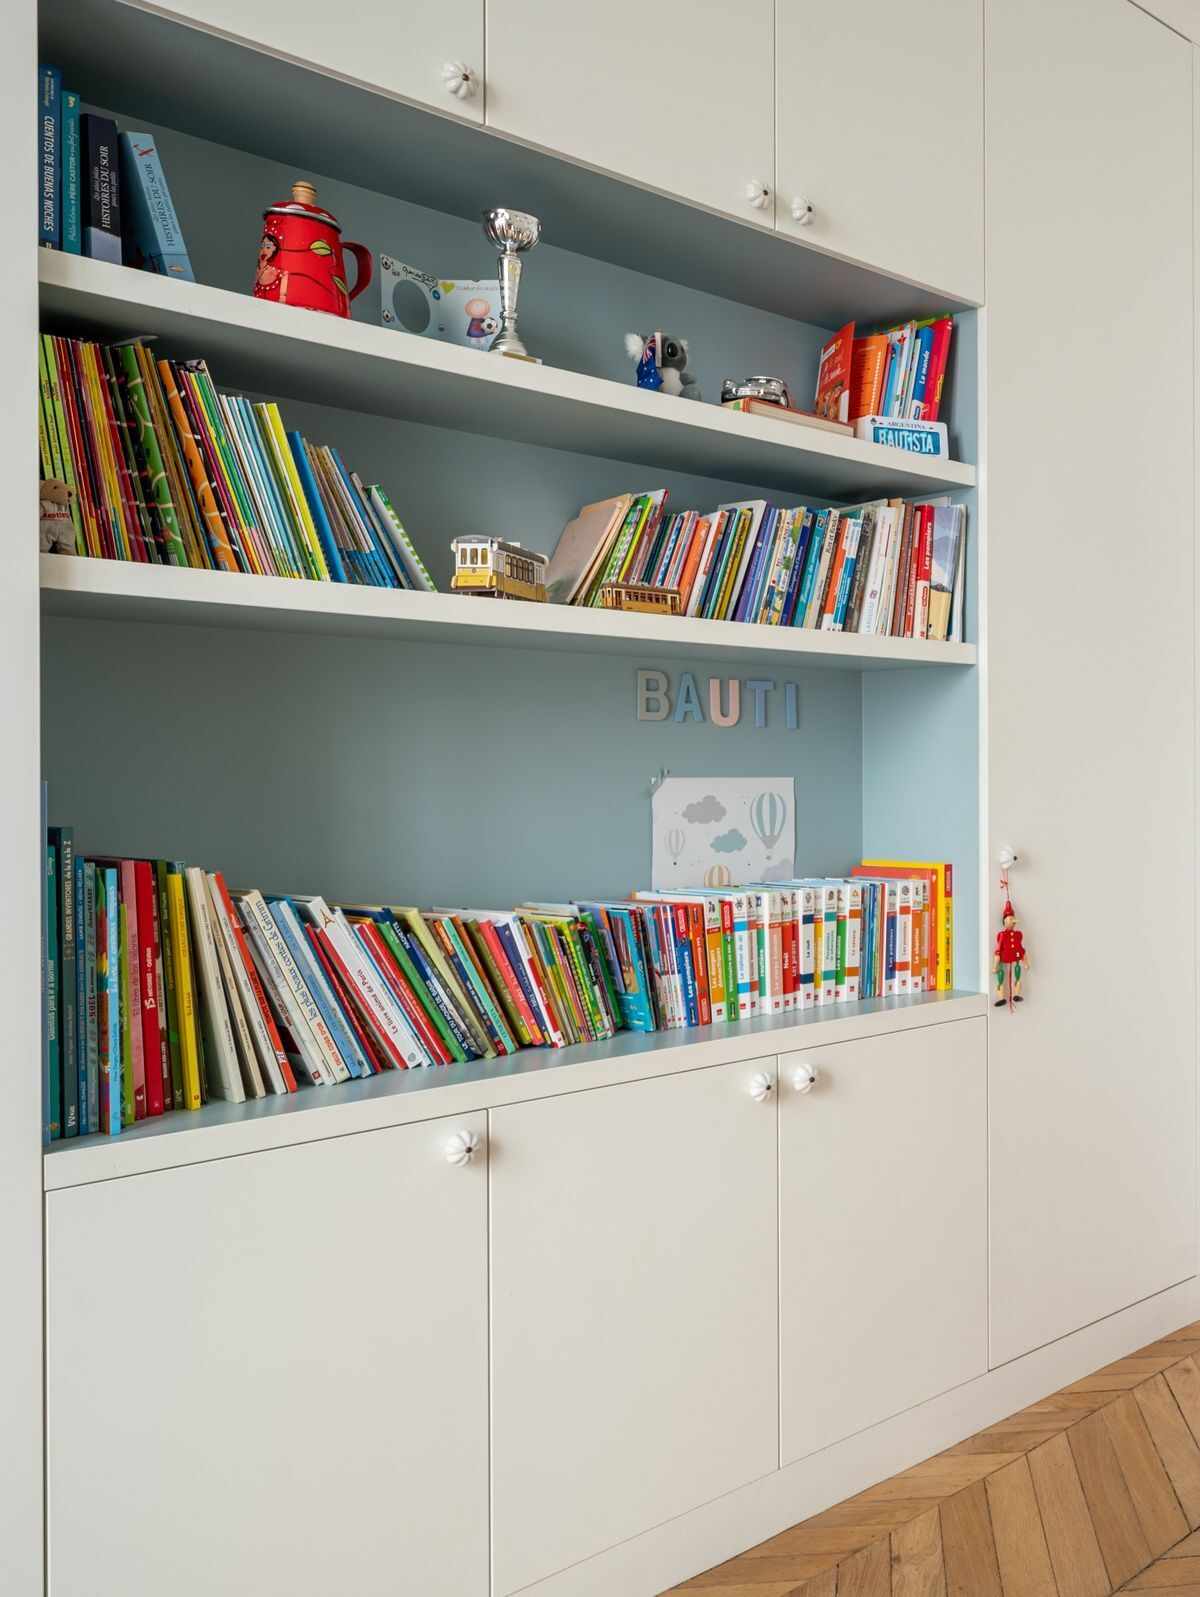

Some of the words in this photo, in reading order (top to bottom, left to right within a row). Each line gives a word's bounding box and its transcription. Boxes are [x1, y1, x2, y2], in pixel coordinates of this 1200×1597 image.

[43, 115, 54, 152] CUENTOS
[43, 153, 53, 163] DE
[99, 145, 109, 166] SOIR
[43, 165, 53, 198] BUENAS
[100, 166, 109, 181] DU
[143, 161, 156, 185] SOIR
[150, 183, 160, 197] DU
[100, 182, 110, 228] HISTOIRES
[43, 199, 53, 231] NOCHES
[154, 196, 175, 247] HISTOIRES
[919, 349, 930, 374] monde
[918, 375, 926, 384] Le
[879, 429, 934, 453] BAUTISTA
[924, 521, 932, 556] pompiers
[864, 601, 875, 632] LAROUSSE
[907, 606, 913, 615] La
[637, 669, 798, 730] BAUTI
[64, 870, 72, 878] de
[64, 879, 73, 914] INVENTORES
[252, 899, 274, 932] Grimm
[65, 915, 73, 940] GRANDES
[268, 929, 279, 942] de
[391, 919, 411, 950] HACHETTE
[273, 939, 292, 968] contes
[695, 946, 705, 976] dinosaures
[708, 949, 717, 976] dangers
[913, 955, 919, 963] Le
[682, 950, 693, 984] pompiers
[714, 946, 724, 988] domestiques
[131, 976, 138, 985] de
[285, 965, 304, 992] beaux
[354, 968, 369, 986] Paris
[773, 981, 779, 990] Le
[363, 984, 373, 994] de
[424, 978, 438, 997] BABAR
[686, 985, 694, 997] Les
[48, 995, 56, 1010] para
[144, 997, 156, 1009] 15
[297, 989, 313, 1008] plus
[369, 992, 385, 1013] animé
[433, 994, 442, 1004] DE
[132, 1007, 140, 1015] El
[305, 1006, 318, 1020] les
[380, 1011, 393, 1026] livre
[438, 1001, 452, 1021] MONDE
[315, 1020, 326, 1036] D'OR
[388, 1024, 399, 1035] Le
[447, 1019, 457, 1029] DU
[323, 1034, 334, 1051] COQS
[452, 1026, 464, 1042] TOUR
[459, 1040, 469, 1050] LE
[331, 1049, 342, 1066] DEUX
